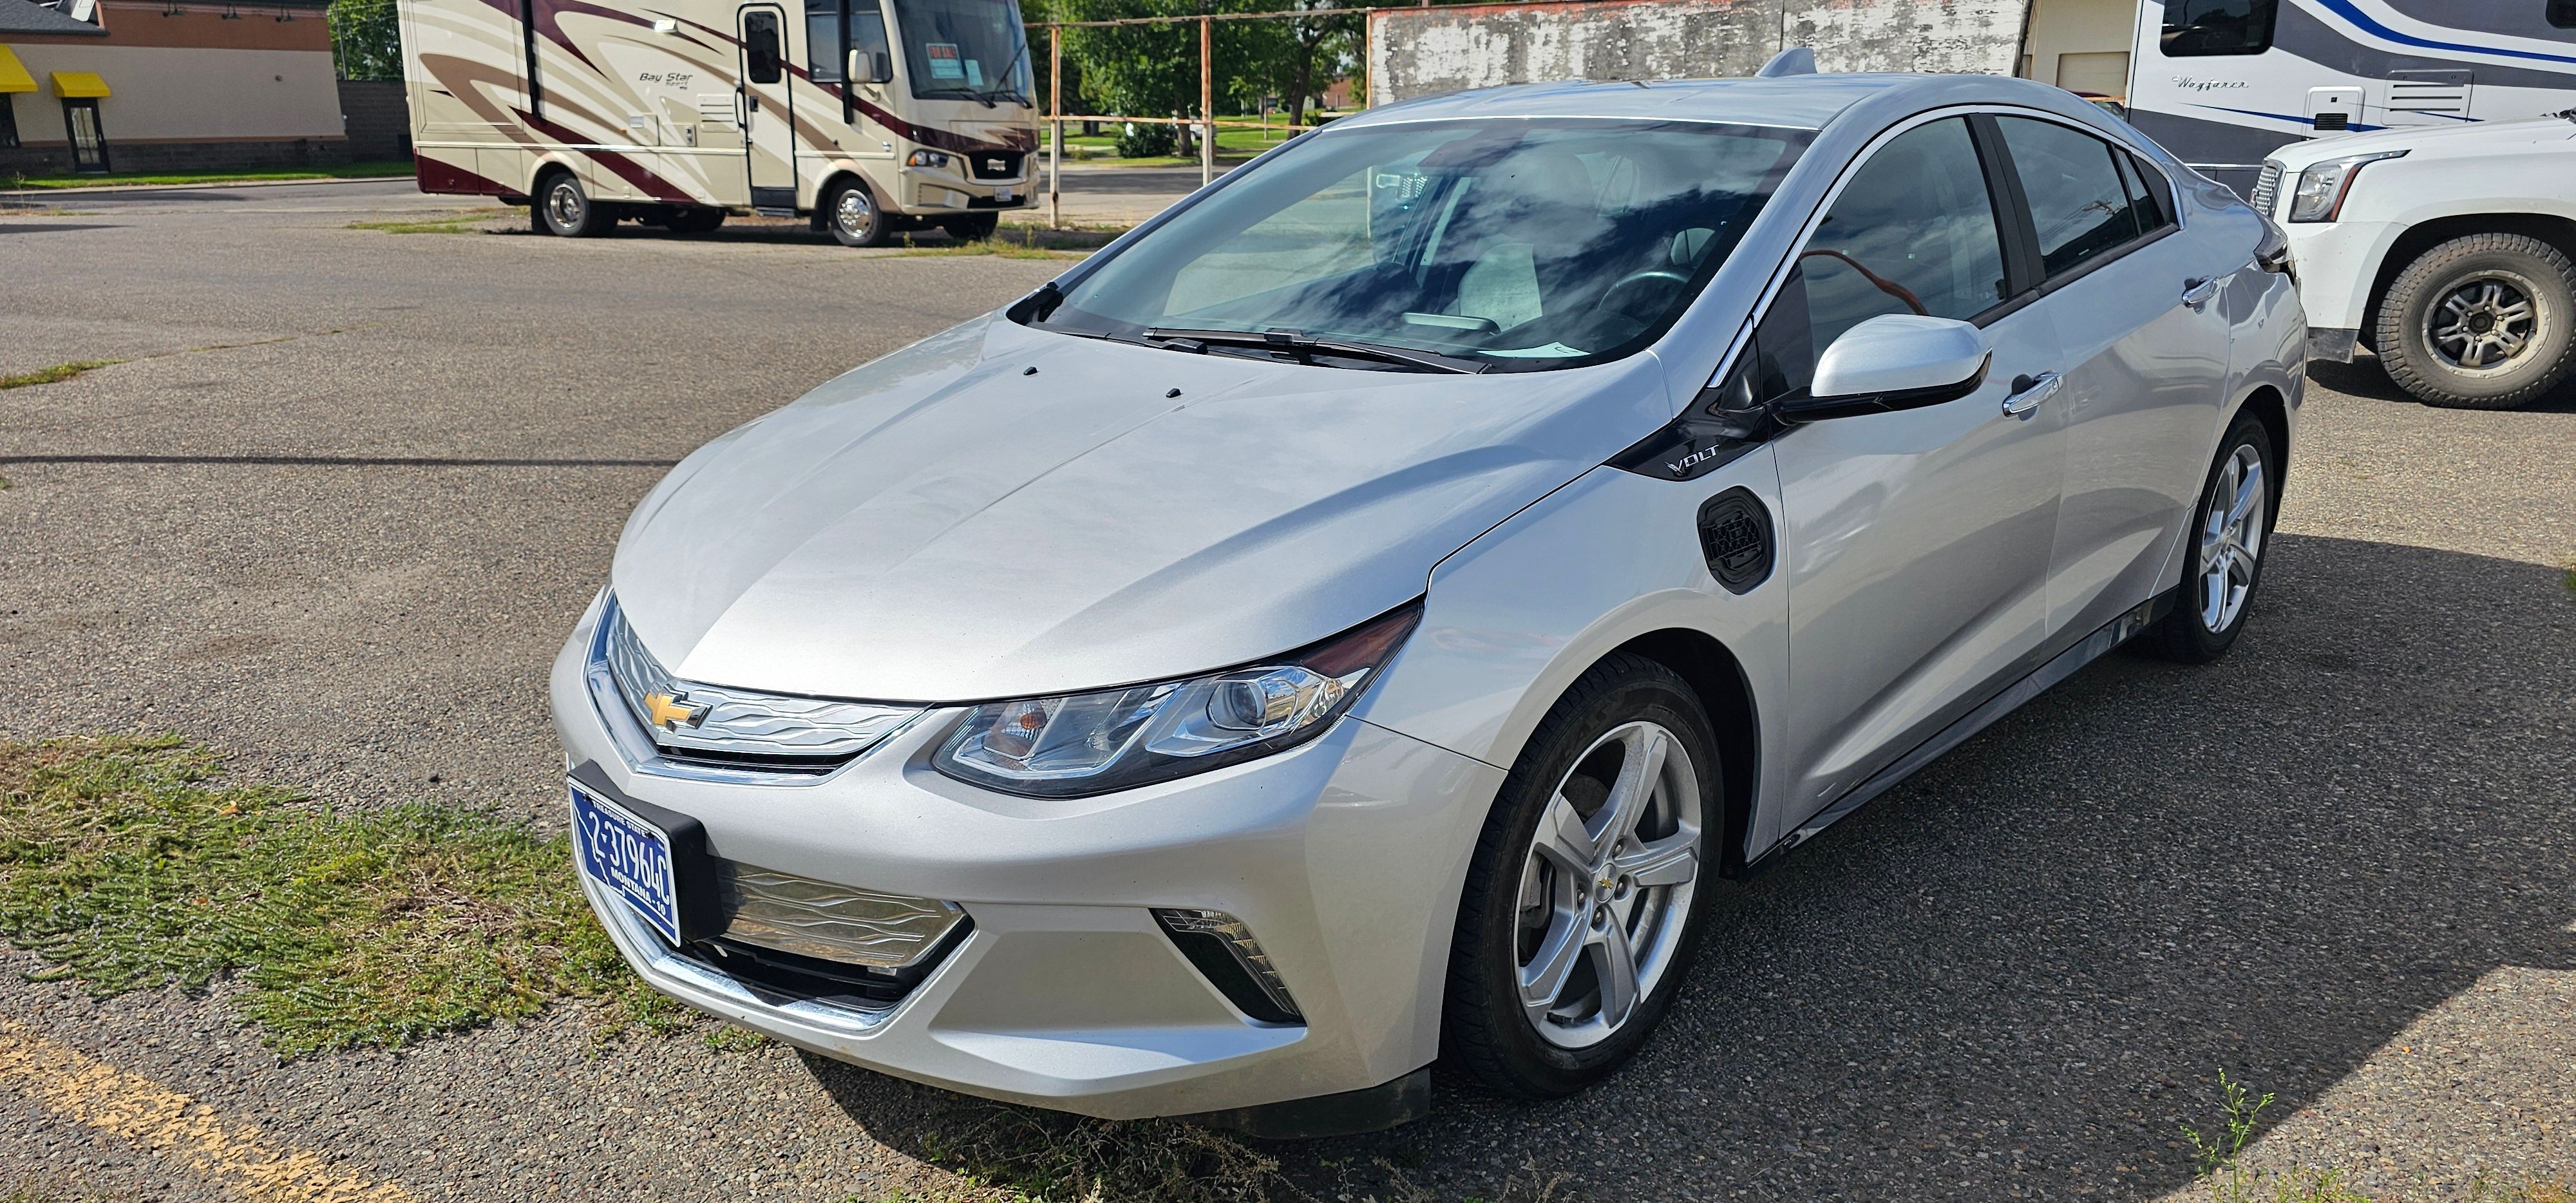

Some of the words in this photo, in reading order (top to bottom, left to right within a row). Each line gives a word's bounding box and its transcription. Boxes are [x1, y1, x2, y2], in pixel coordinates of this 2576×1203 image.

[639, 73, 663, 83] Bay
[666, 73, 694, 81] Star
[2172, 75, 2249, 91] Wayfarer
[1663, 444, 1719, 474] VOLT
[592, 799, 626, 826] TREASURE
[626, 820, 649, 838] STATE
